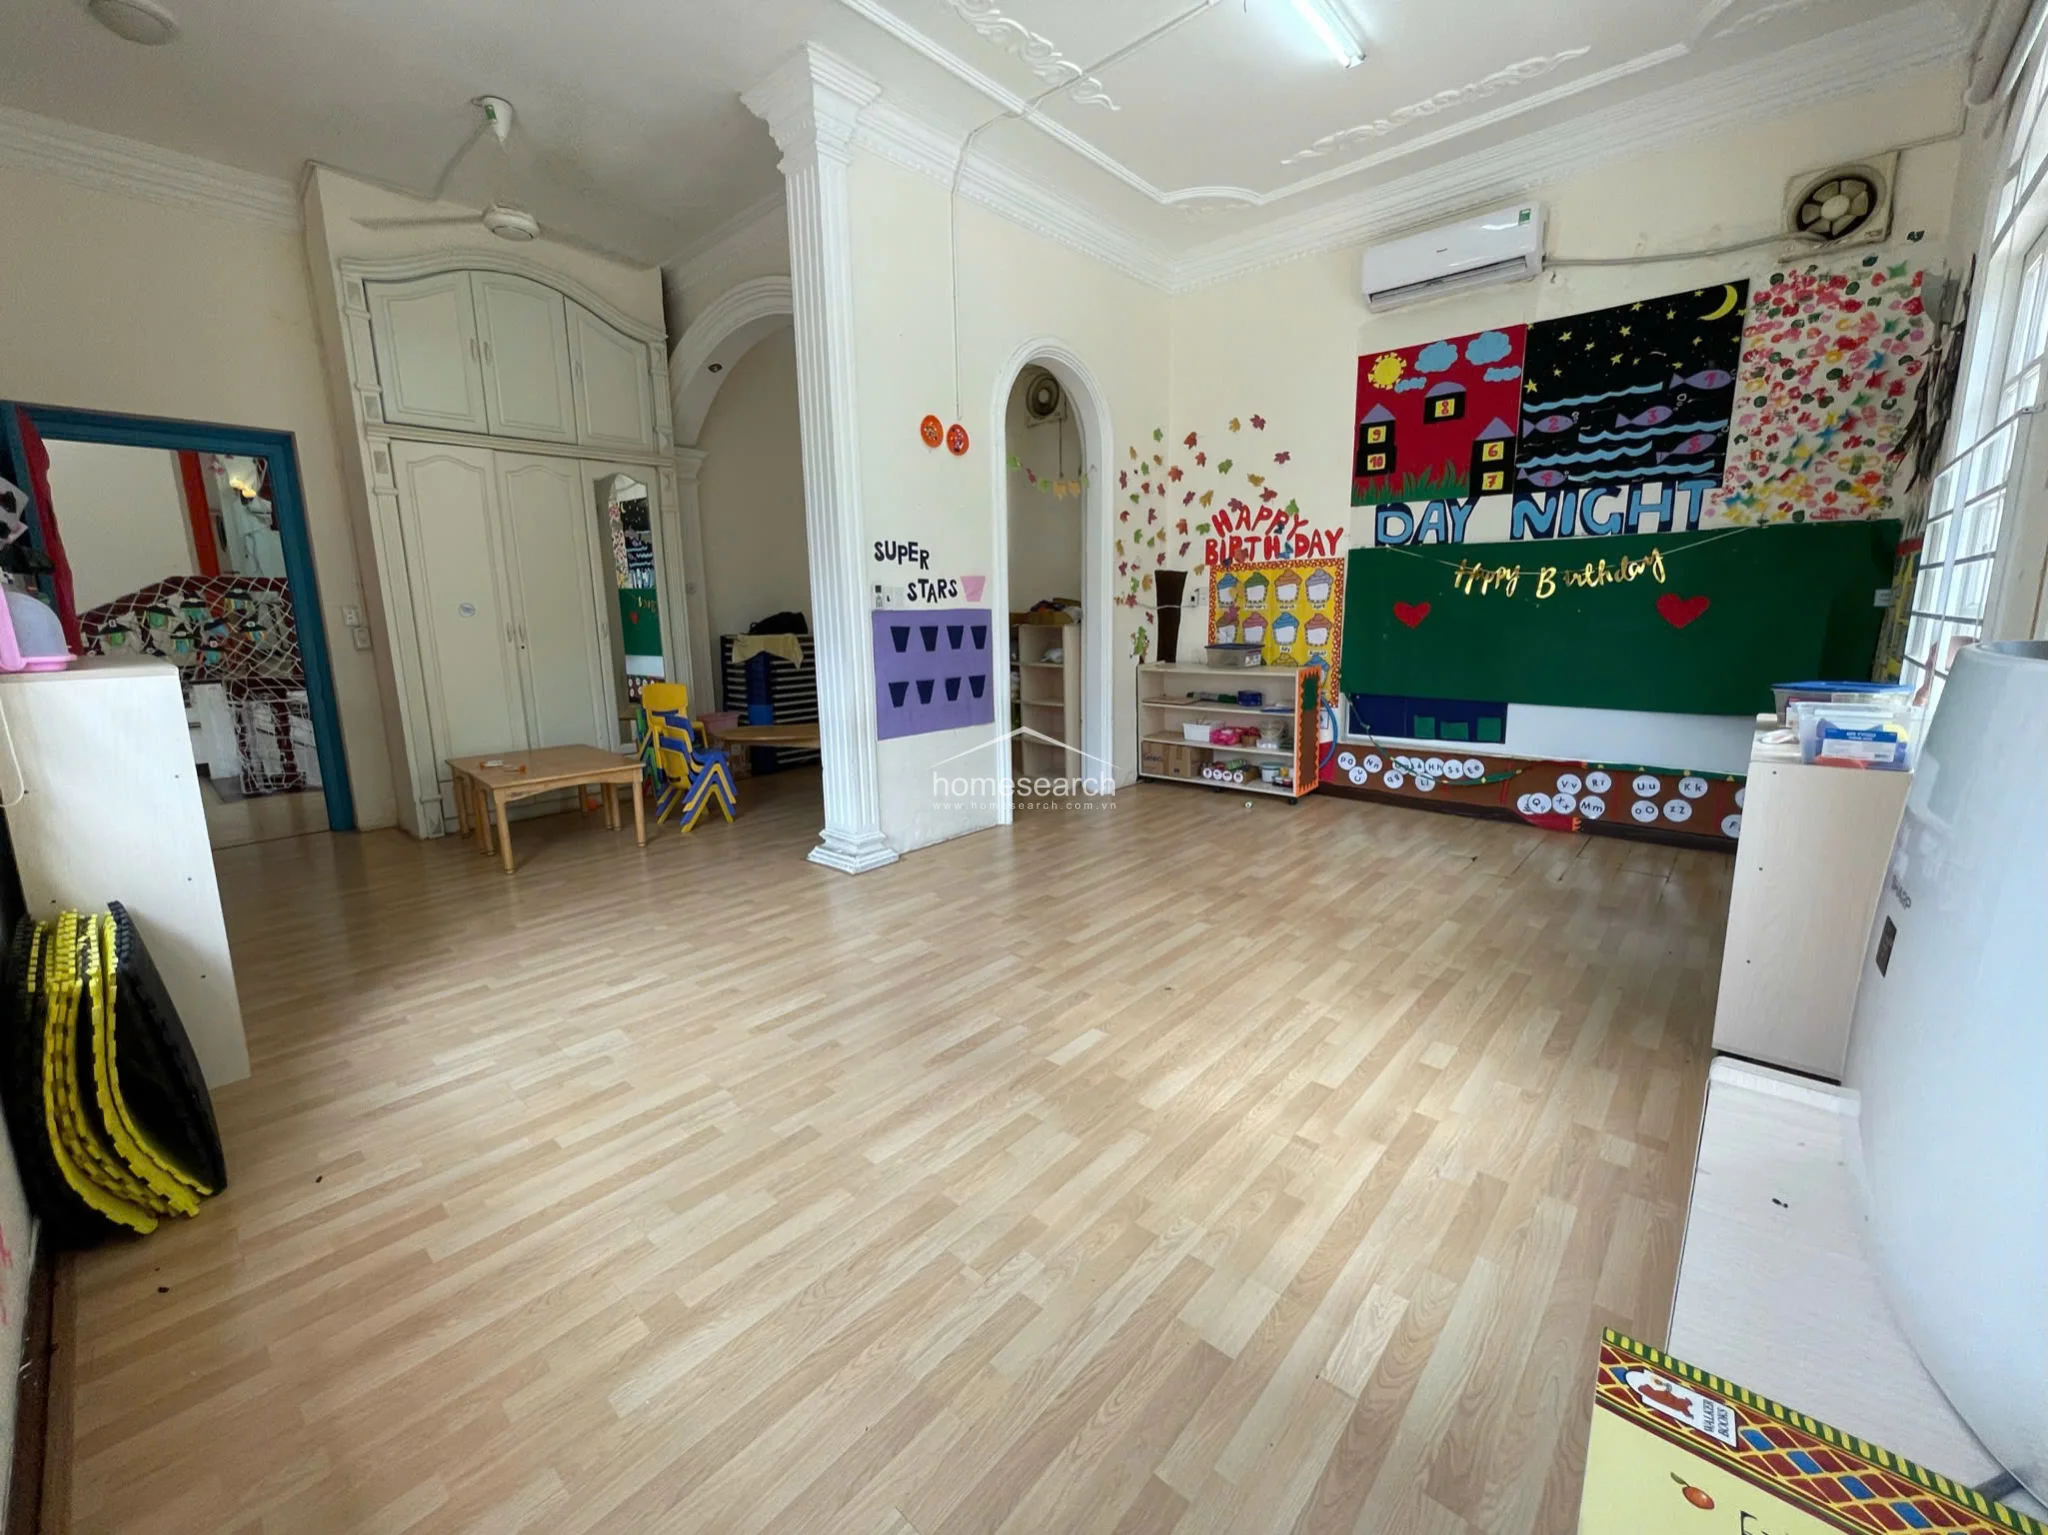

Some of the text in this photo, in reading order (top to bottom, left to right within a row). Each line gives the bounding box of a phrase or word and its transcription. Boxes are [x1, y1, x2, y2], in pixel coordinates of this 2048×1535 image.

[1705, 372, 1717, 386] 1
[1441, 400, 1449, 415] 8
[1547, 415, 1559, 431] 2
[1648, 409, 1658, 424] 3
[1373, 429, 1381, 441] 9
[1488, 444, 1498, 457] 6
[1688, 435, 1701, 452] 5
[1369, 456, 1383, 468] 10
[1487, 475, 1497, 488] 7
[1375, 481, 1719, 546] DAY NIGHT
[1211, 505, 1309, 541] HAPPY
[874, 540, 930, 570] SUPER
[907, 578, 958, 603] STARS
[1703, 1399, 1714, 1432] WALKER
[1717, 1407, 1729, 1438] BOOKS
